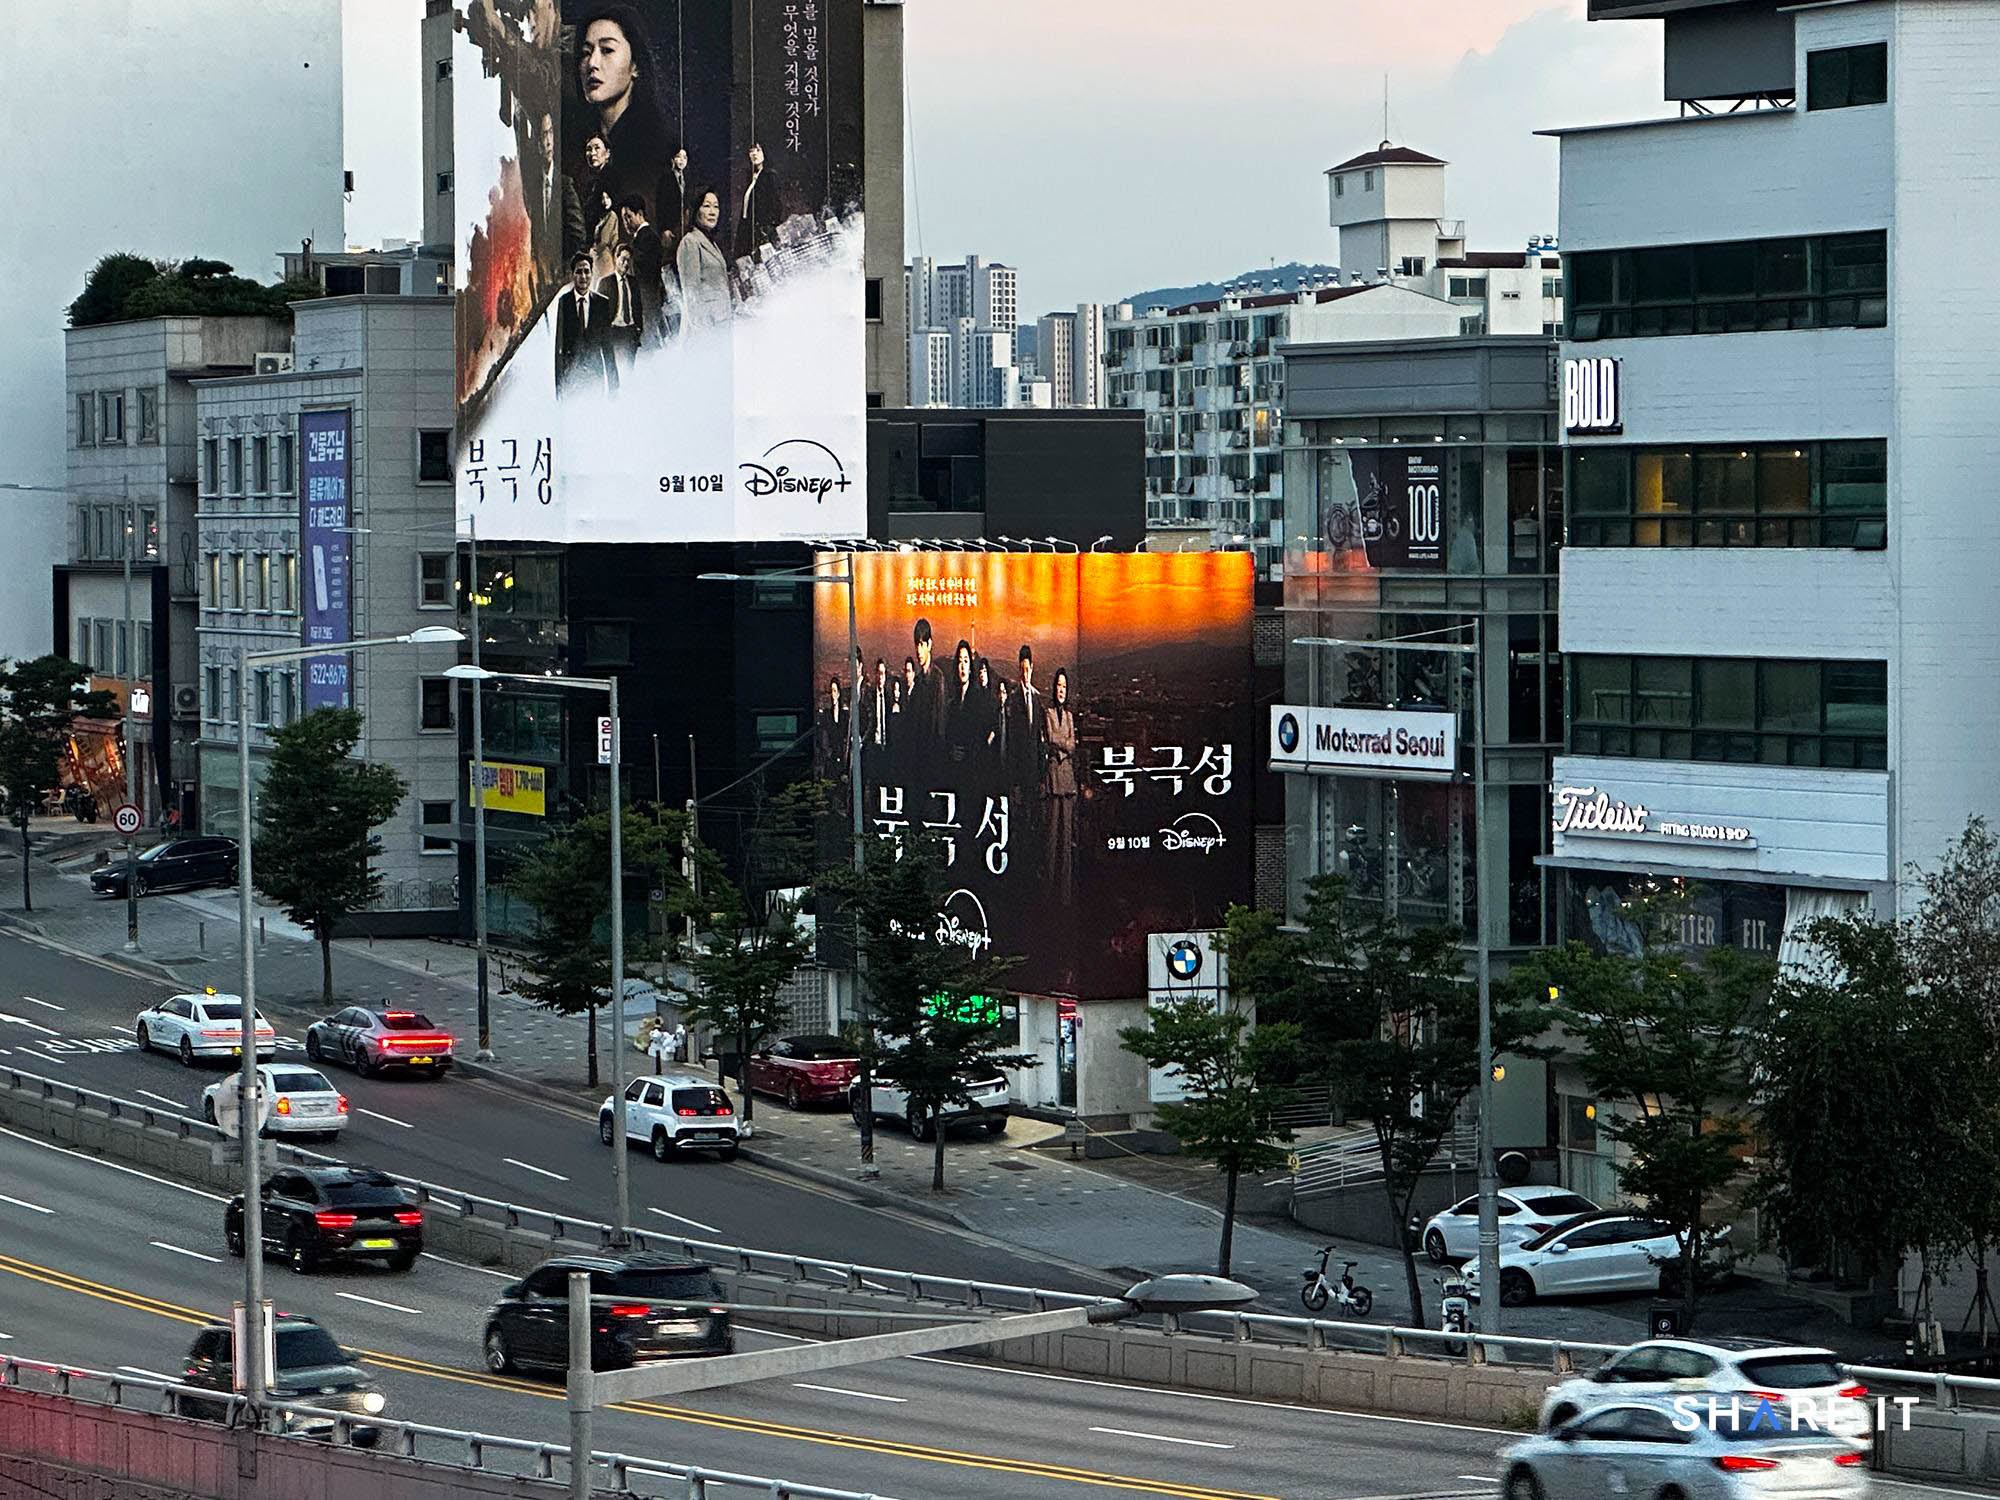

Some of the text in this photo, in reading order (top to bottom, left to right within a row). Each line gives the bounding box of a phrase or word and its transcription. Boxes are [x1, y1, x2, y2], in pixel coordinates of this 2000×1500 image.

[783, 5, 801, 152] 무엇을 지킬 것인가
[803, 0, 820, 117] 를 믿을 것인가
[1565, 358, 1615, 428] BOLD
[309, 430, 345, 462] 건물주님
[466, 437, 552, 505] 북극성
[659, 474, 723, 493] 9월 10일
[1407, 484, 1439, 541] 100
[310, 664, 347, 685] 1522-8679
[1316, 724, 1392, 755] Motorrad
[1094, 744, 1232, 798] 북극성
[119, 813, 136, 826] 60
[873, 786, 1009, 875] 북극성
[1552, 786, 1648, 832] Titleist
[1108, 836, 1150, 850] 9월 10일
